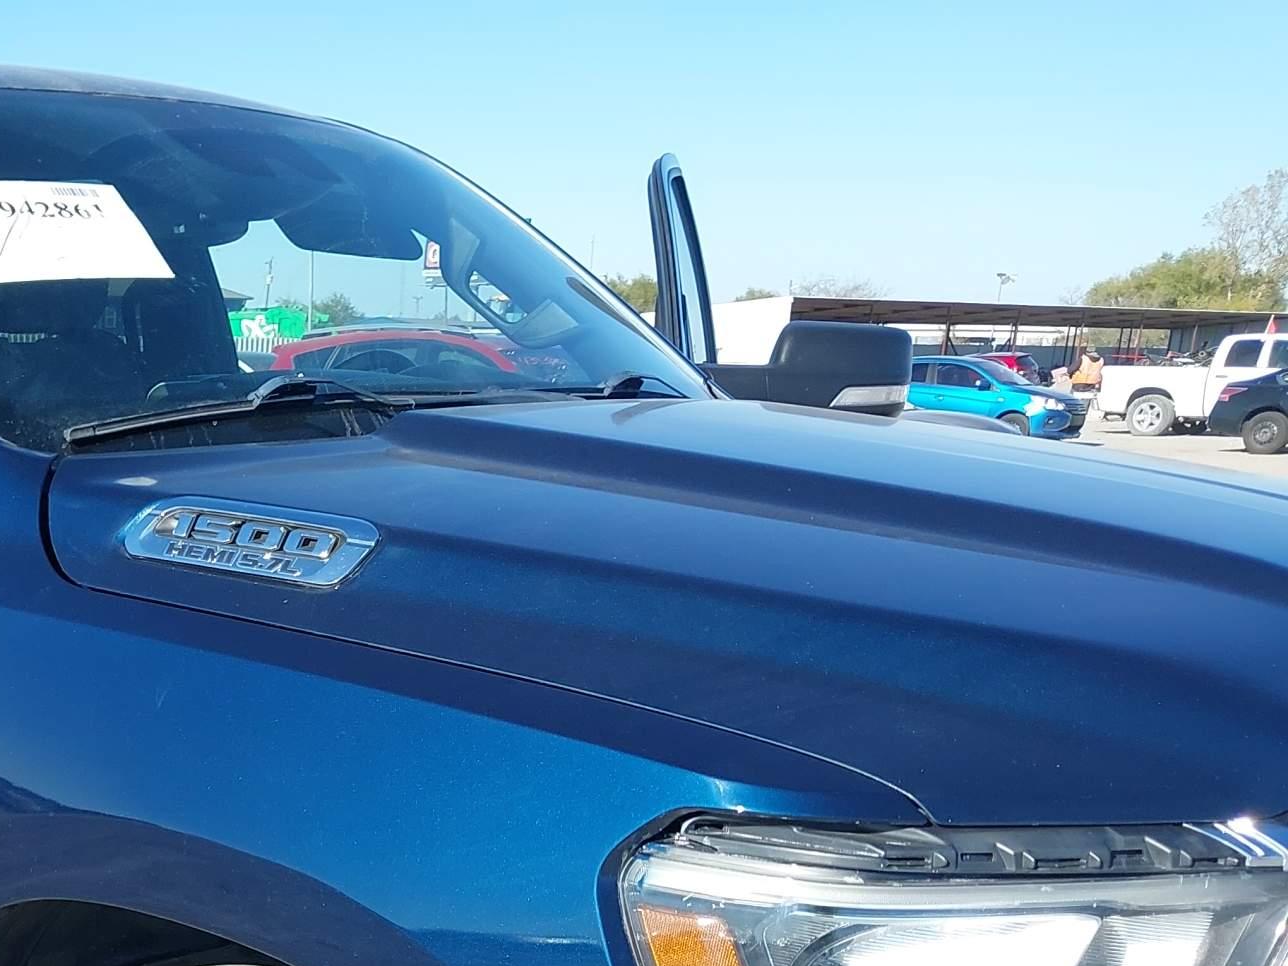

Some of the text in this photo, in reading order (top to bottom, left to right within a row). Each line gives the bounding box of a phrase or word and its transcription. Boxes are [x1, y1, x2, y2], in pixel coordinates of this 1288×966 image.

[172, 511, 335, 560] 1500
[164, 540, 302, 577] HEMI 5.7L
